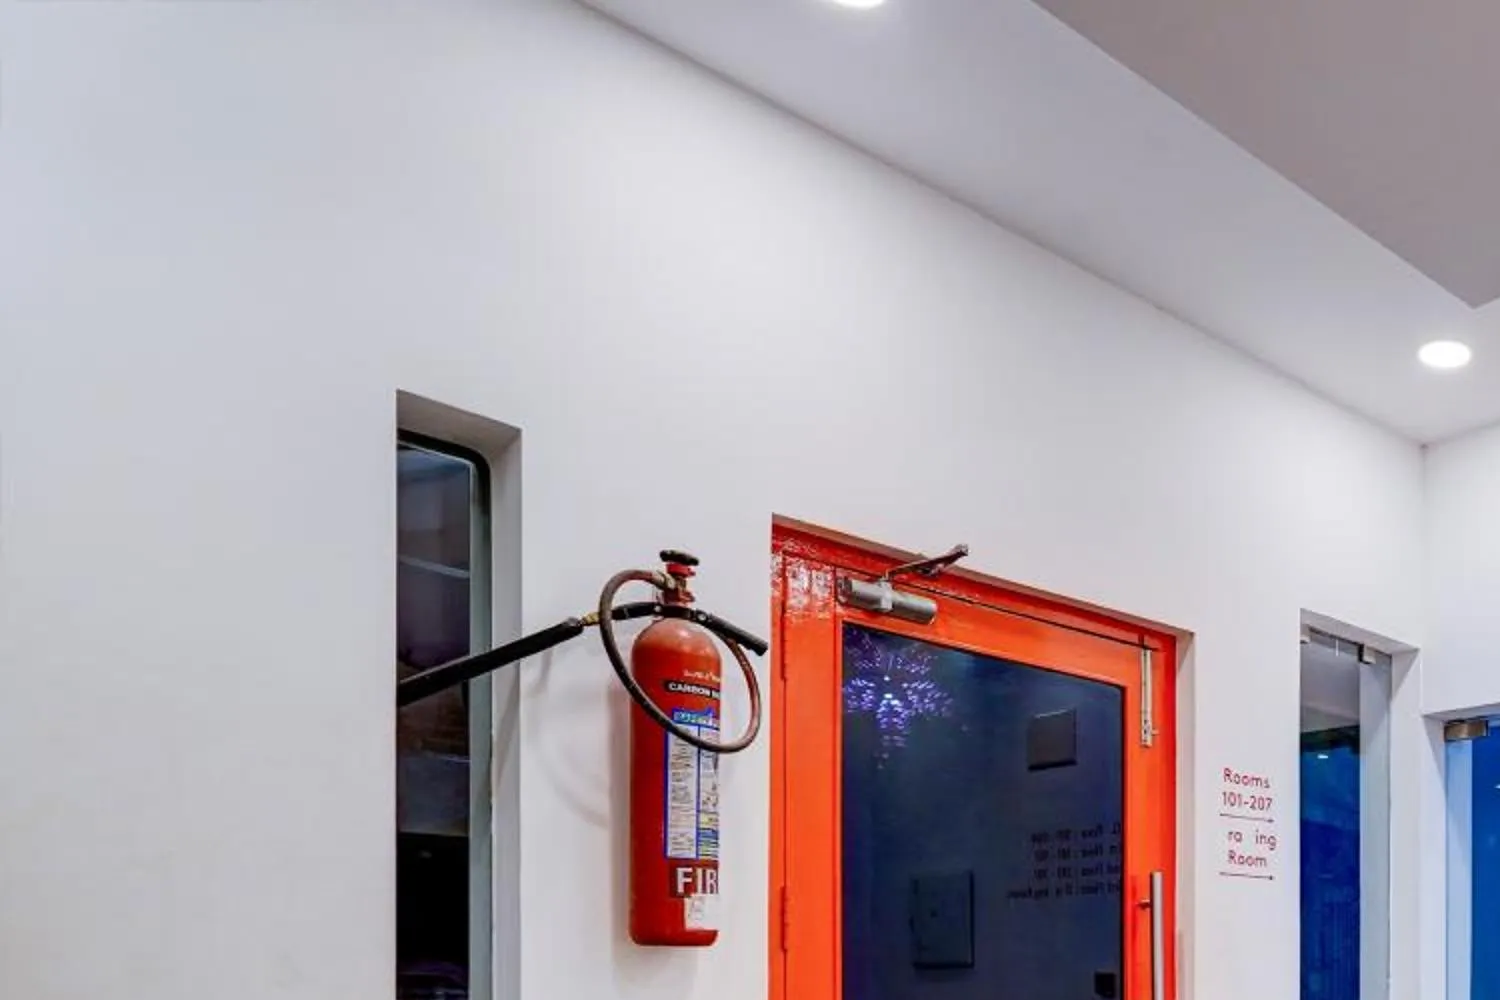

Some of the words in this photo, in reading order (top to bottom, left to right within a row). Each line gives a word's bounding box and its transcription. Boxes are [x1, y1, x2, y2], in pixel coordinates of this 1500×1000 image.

[1223, 767, 1271, 788] Rooms
[1222, 791, 1273, 811] 101-207
[1227, 849, 1268, 868] Room
